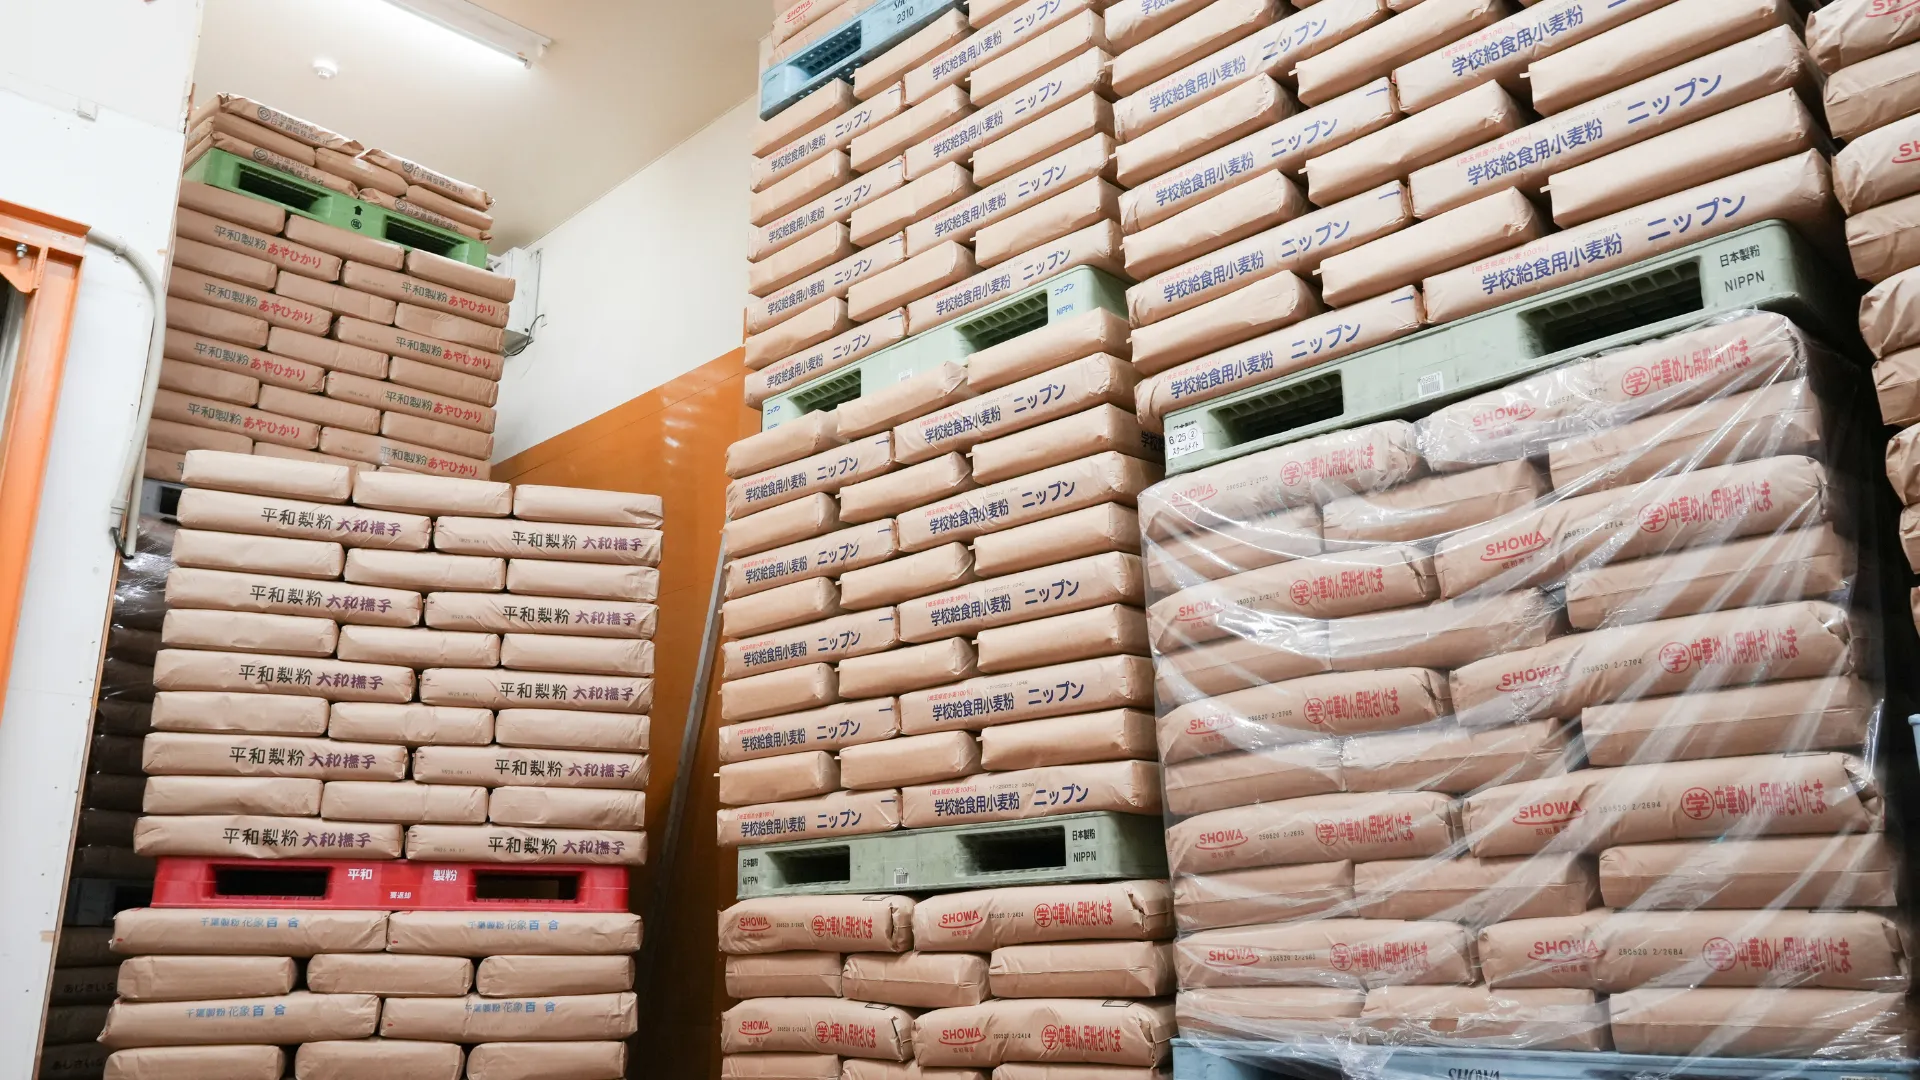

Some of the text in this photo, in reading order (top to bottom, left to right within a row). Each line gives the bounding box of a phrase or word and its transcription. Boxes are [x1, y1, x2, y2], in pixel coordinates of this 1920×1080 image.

[896, 6, 914, 25] 2310
[932, 30, 1002, 81] 学校給食用小麦粉
[1452, 4, 1583, 77] 学校給食用小麦粉
[1149, 18, 1327, 113] 学校給食用小麦粉 ニップン
[933, 81, 1062, 158] 学校給食用小麦粉 ニップン
[1467, 117, 1603, 186] 学校給食用小麦粉
[1627, 74, 1722, 125] ニップン
[770, 109, 873, 173] 学校給食用小麦粉 ニップン
[1155, 151, 1254, 207] 学校給食用小麦粉
[1271, 118, 1337, 157] ニップン
[768, 184, 872, 244] 学校給食用小麦粉 ニップン
[934, 165, 1067, 237] 学校給食用小麦粉 ニップン
[214, 225, 321, 268] 平和製粉 あやひかり
[1163, 221, 1350, 303] 学校給食用小麦粉 ニップン
[1482, 232, 1623, 296] 学校給食用小麦粉
[1648, 195, 1746, 242] ニップン
[1719, 245, 1761, 268] 日本製粉
[767, 259, 873, 316] 学校給食用小麦粉 ニップン
[935, 249, 1071, 316] 学校給食用小麦粉 ニップン
[1724, 270, 1765, 292] NIPPN
[204, 282, 313, 324] 平和製粉 あやひかり
[401, 281, 448, 303] 平和製粉
[448, 295, 496, 317] あやひかり
[194, 342, 306, 382] 平和製粉 あやひかり
[396, 336, 442, 357] 平和製粉
[443, 348, 491, 369] あやひかり
[766, 333, 871, 389] 学校給食用小麦粉 ニップン
[1170, 324, 1361, 399] 学校給食用小麦粉 ニップン
[187, 402, 300, 439] 平和製粉 あやひかり
[385, 390, 433, 412] 平和製粉
[433, 402, 482, 423] あやひかり
[924, 383, 1066, 444] 学校給食用小麦粉 ニップン
[1472, 402, 1533, 427] SHOWA
[381, 445, 478, 477] 平和製粉 あやひかり
[745, 472, 807, 502] 学校給食用小麦粉
[817, 457, 858, 481] ニップン
[261, 507, 402, 537] 平和製粉 大和撫子
[929, 480, 1075, 535] 学校給食用小麦粉 ニップン
[511, 530, 578, 550] 平和製粉
[582, 535, 643, 552] 大和撫子
[1485, 530, 1547, 556] SHOWA
[745, 543, 859, 584] 学校給食用小麦粉 ニップン
[250, 584, 393, 613] 平和製粉 大和撫子
[930, 593, 1011, 627] 学校給食用小麦粉
[1025, 578, 1079, 605] ニップン
[502, 605, 636, 627] 平和製粉 大和撫子
[743, 630, 861, 667] 学校給食用小麦粉 ニップン
[238, 664, 384, 690] 平和製粉 大和撫子
[1501, 665, 1564, 687] SHOWA
[1614, 657, 1643, 669] 2/2704
[499, 682, 635, 701] 平和製粉 大和撫子
[932, 680, 1084, 722] 学校給食用小麦粉 ニップン
[741, 719, 861, 752] 学校給食用小麦粉 ニップン
[229, 746, 377, 770] 平和製粉 大和撫子
[494, 759, 630, 779] 平和製粉 大和撫子
[934, 791, 1020, 817] 学校給食用小麦粉
[1033, 783, 1089, 806] ニップン
[1518, 800, 1582, 819] SHOWA
[222, 827, 372, 848] 平和製粉 大和撫子
[740, 808, 862, 838] 学校給食用小麦粉 ニップン
[1072, 828, 1096, 841] 日本製粉
[1200, 829, 1244, 844] SHOWA
[487, 836, 626, 856] 平和製粉 大和撫子
[1073, 851, 1097, 862] NIPPN
[347, 868, 457, 882] 平和 製粉
[740, 916, 768, 927] SHOWA
[941, 909, 980, 924] SHOWA
[1208, 948, 1255, 961] SHOWA
[1534, 939, 1598, 957] SHOWA
[741, 1020, 769, 1031] SHOWA
[942, 1027, 982, 1040] SHOWA
